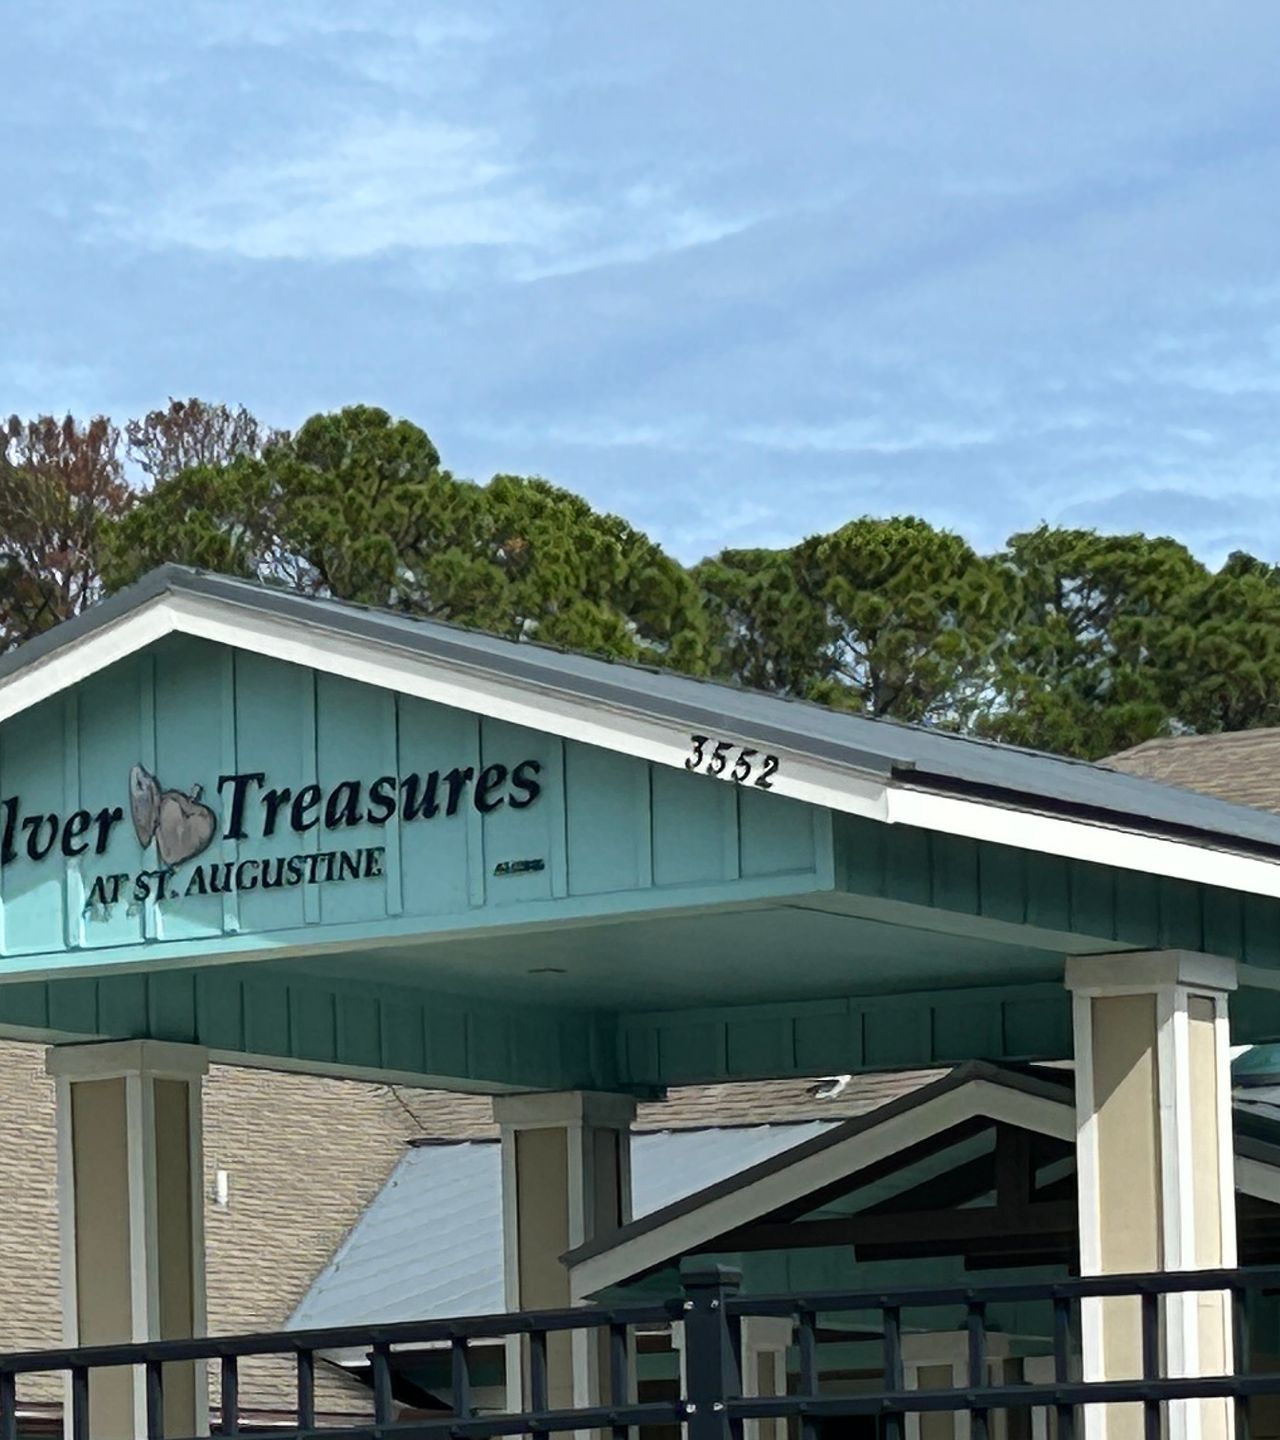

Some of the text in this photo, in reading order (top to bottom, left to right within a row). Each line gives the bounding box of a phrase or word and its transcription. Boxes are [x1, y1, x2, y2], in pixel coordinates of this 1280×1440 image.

[685, 734, 779, 789] 3552
[217, 760, 541, 840] Treasures
[84, 846, 386, 906] AT ST. AUGUSTINE
